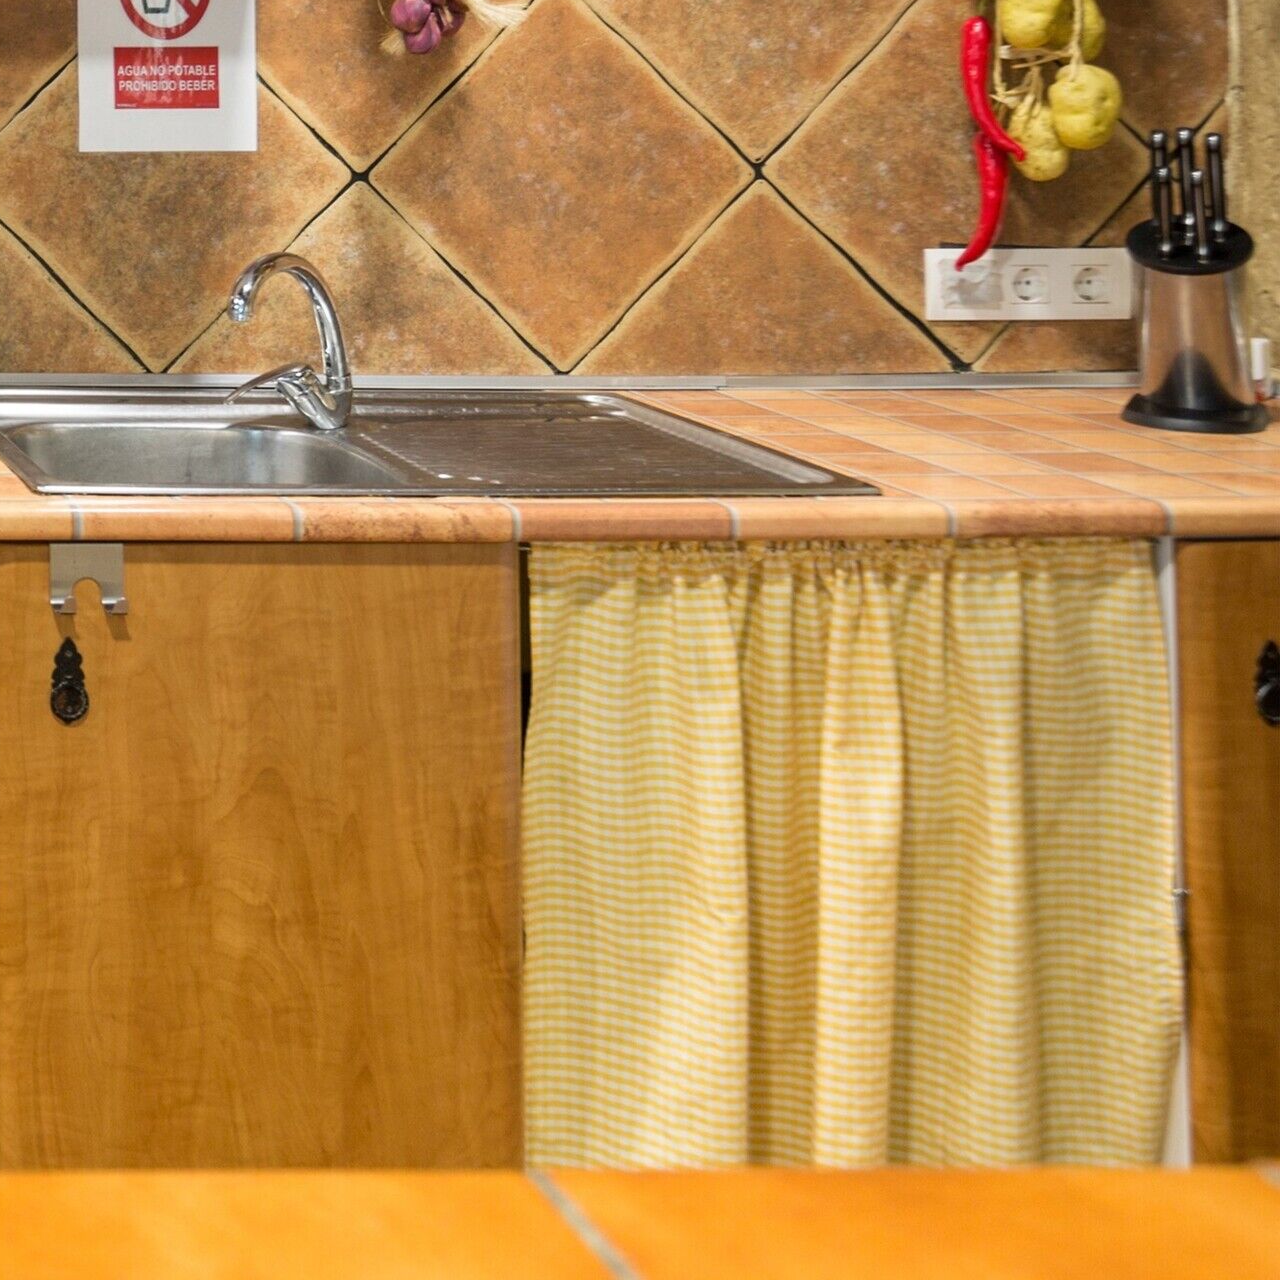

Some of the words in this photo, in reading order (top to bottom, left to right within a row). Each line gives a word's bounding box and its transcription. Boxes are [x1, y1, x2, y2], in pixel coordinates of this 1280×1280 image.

[117, 64, 148, 76] AGUA
[149, 64, 166, 76] NO
[168, 64, 216, 76] POTABLE
[119, 80, 177, 92] PROHIBIDO
[179, 80, 216, 91] BEBER
